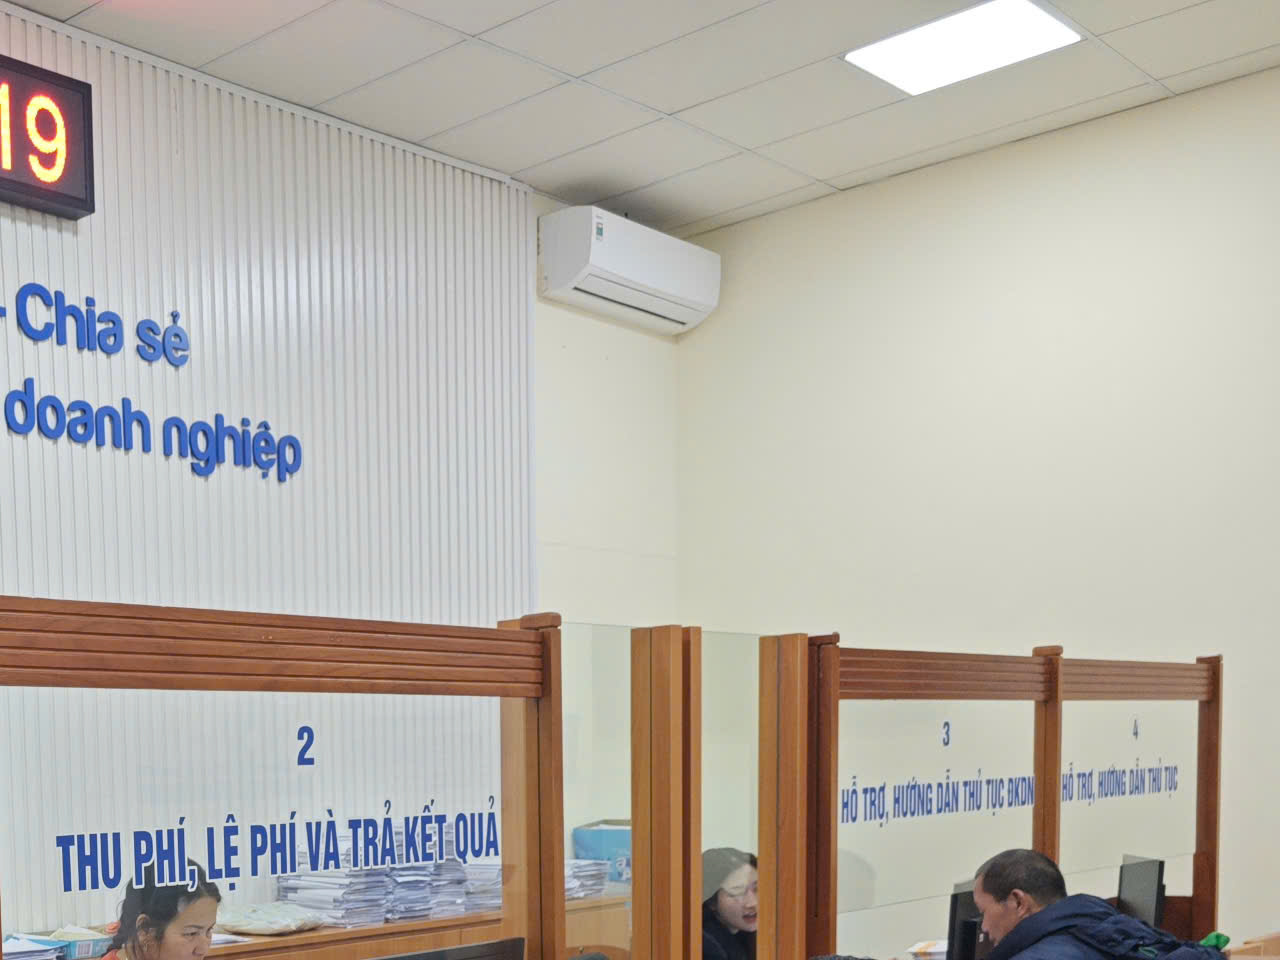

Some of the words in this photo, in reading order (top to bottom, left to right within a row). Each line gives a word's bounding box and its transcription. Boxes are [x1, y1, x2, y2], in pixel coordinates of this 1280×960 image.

[15, 282, 124, 355] Chia
[135, 309, 190, 367] sẻ
[4, 377, 151, 454] doanh
[162, 413, 303, 483] nghiệp
[297, 725, 315, 766] 2
[941, 720, 951, 747] 3
[1132, 719, 1139, 741] 4
[841, 775, 859, 824] HỖ
[862, 782, 889, 828] TRỢ,
[893, 776, 933, 818] HƯỚNG
[936, 769, 960, 814] DẪN
[963, 768, 983, 813] THỦ
[986, 777, 1005, 816] TỤC
[1164, 766, 1179, 799] TỤC
[55, 831, 122, 893] THU
[132, 816, 199, 893] PHÍ,
[206, 813, 241, 891] LỆ
[250, 810, 298, 876] PHÍ
[305, 808, 341, 873] VÀ
[348, 799, 398, 868] TRẢ
[404, 798, 447, 864] KẾT
[455, 795, 500, 865] QUẢ
